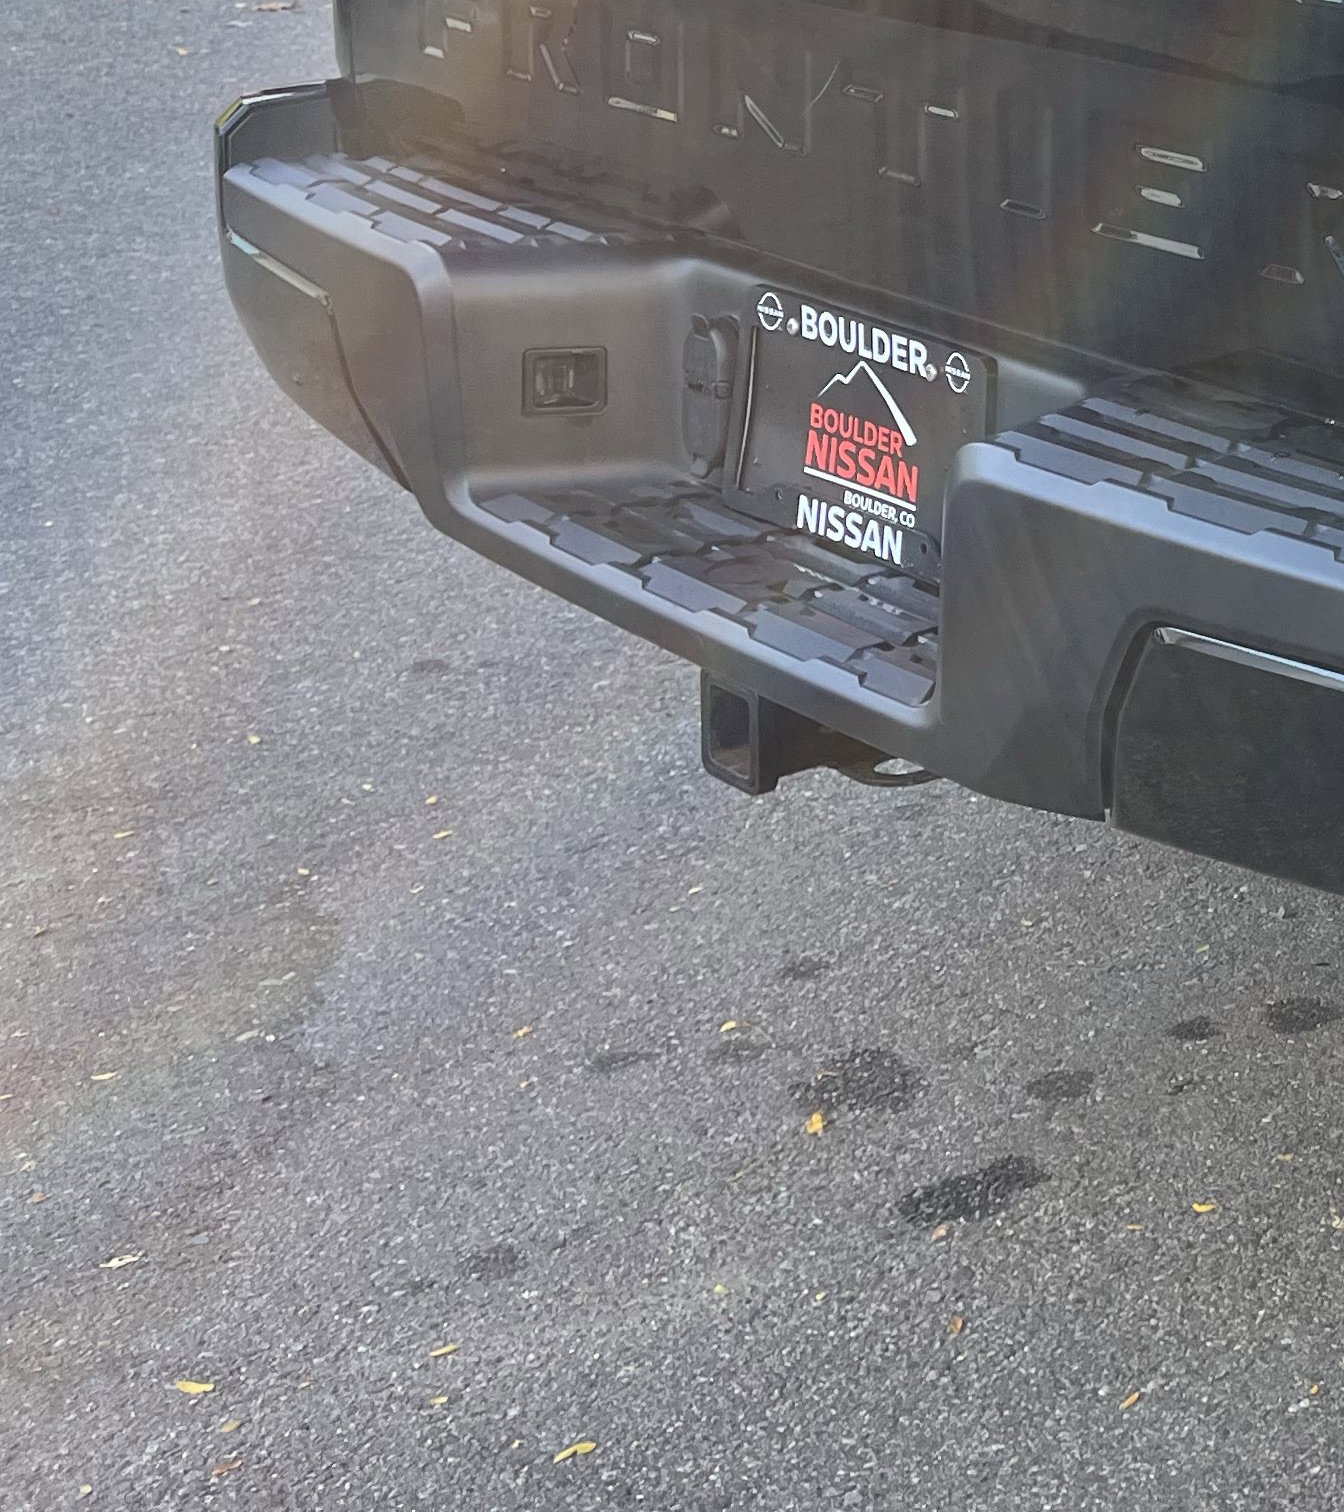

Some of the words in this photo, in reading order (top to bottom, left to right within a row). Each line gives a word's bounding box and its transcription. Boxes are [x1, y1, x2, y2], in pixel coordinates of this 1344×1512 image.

[800, 304, 928, 378] BOULDER
[810, 402, 903, 457] BOULDER
[804, 430, 919, 503] NISSAN
[796, 494, 903, 565] NISSAN
[843, 490, 898, 524] BOULDER,
[899, 510, 916, 528] CO
